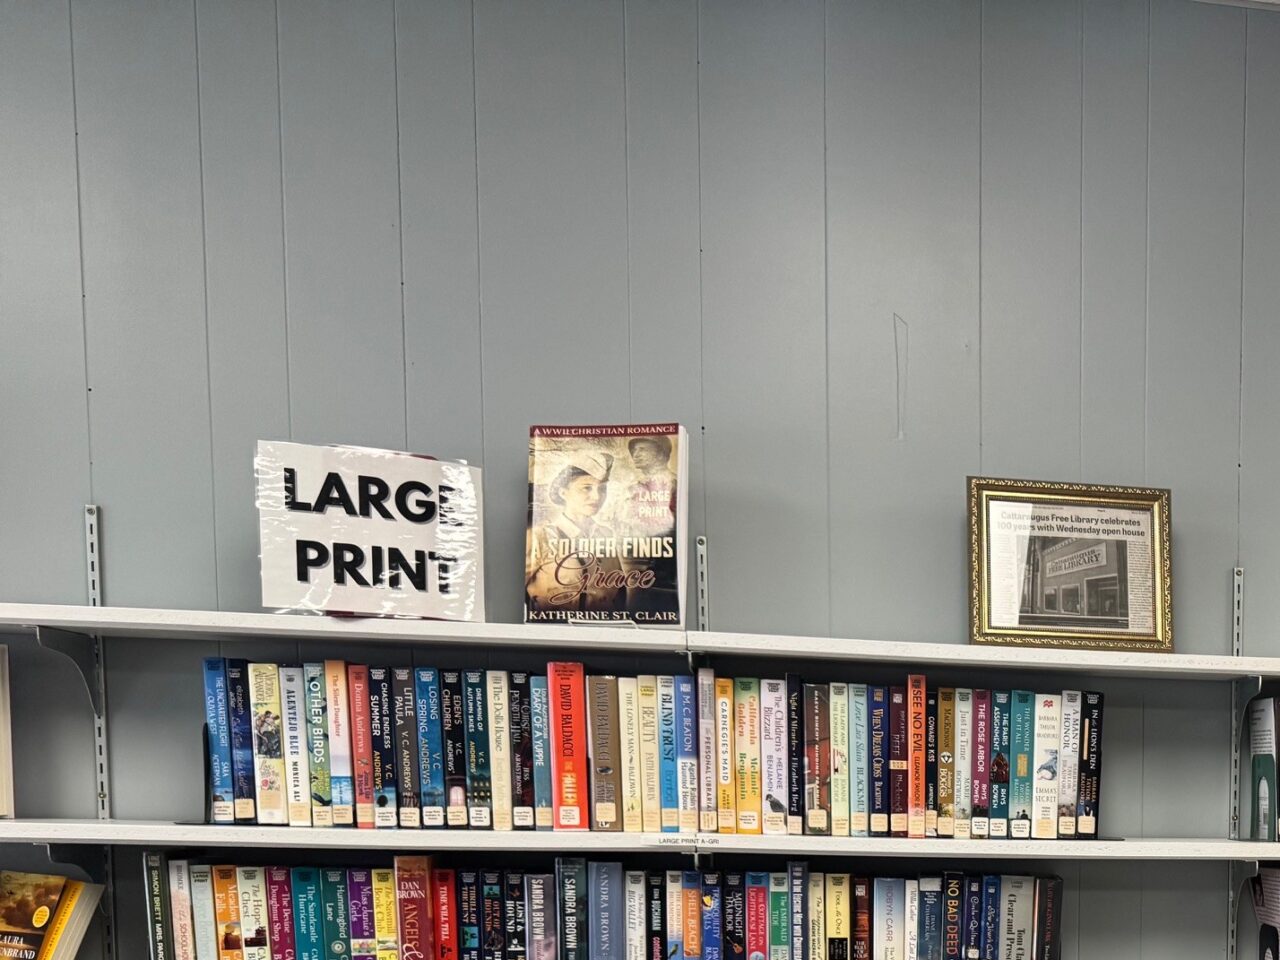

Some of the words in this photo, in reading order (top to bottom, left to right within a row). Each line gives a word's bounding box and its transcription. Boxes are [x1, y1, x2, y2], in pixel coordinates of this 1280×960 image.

[571, 427, 625, 435] CHRISTIAN
[627, 426, 675, 434] ROMANCE
[638, 491, 670, 501] LARGE
[638, 507, 668, 517] PRINT
[1001, 512, 1050, 522] Cattaraugus
[1051, 514, 1069, 523] Free
[1070, 516, 1099, 525] Library
[1100, 517, 1141, 526] celebrates
[1056, 525, 1100, 536] Wednesday
[1102, 528, 1121, 537] open
[1122, 528, 1145, 537] house
[550, 537, 616, 558] SOLDIER
[623, 537, 673, 558] FINDS
[296, 540, 458, 594] PRINT
[549, 551, 656, 605] Grace
[529, 611, 609, 620] KATHERINE
[635, 612, 677, 620] CLAIR
[309, 682, 322, 722] OTHER
[428, 685, 438, 720] LOSING
[560, 684, 572, 711] DAVID
[913, 689, 922, 708] SEE
[371, 695, 381, 737] SUMMER
[418, 699, 428, 733] SPRING
[720, 701, 728, 756] CARNEGIE'S
[913, 711, 922, 730] NO
[313, 727, 324, 764] BIRDS
[560, 714, 573, 757] BALDACCI
[912, 734, 923, 753] EVIL
[397, 889, 425, 899] BROWN
[401, 880, 420, 890] DAN
[532, 879, 544, 911] SANDRA
[565, 878, 576, 913] SANDRA
[948, 879, 959, 896] NO
[336, 885, 347, 939] Hummingbird
[947, 900, 959, 923] BAD
[532, 913, 544, 941] BROWN
[565, 916, 576, 948] BROWN
[946, 925, 958, 955] DEED
